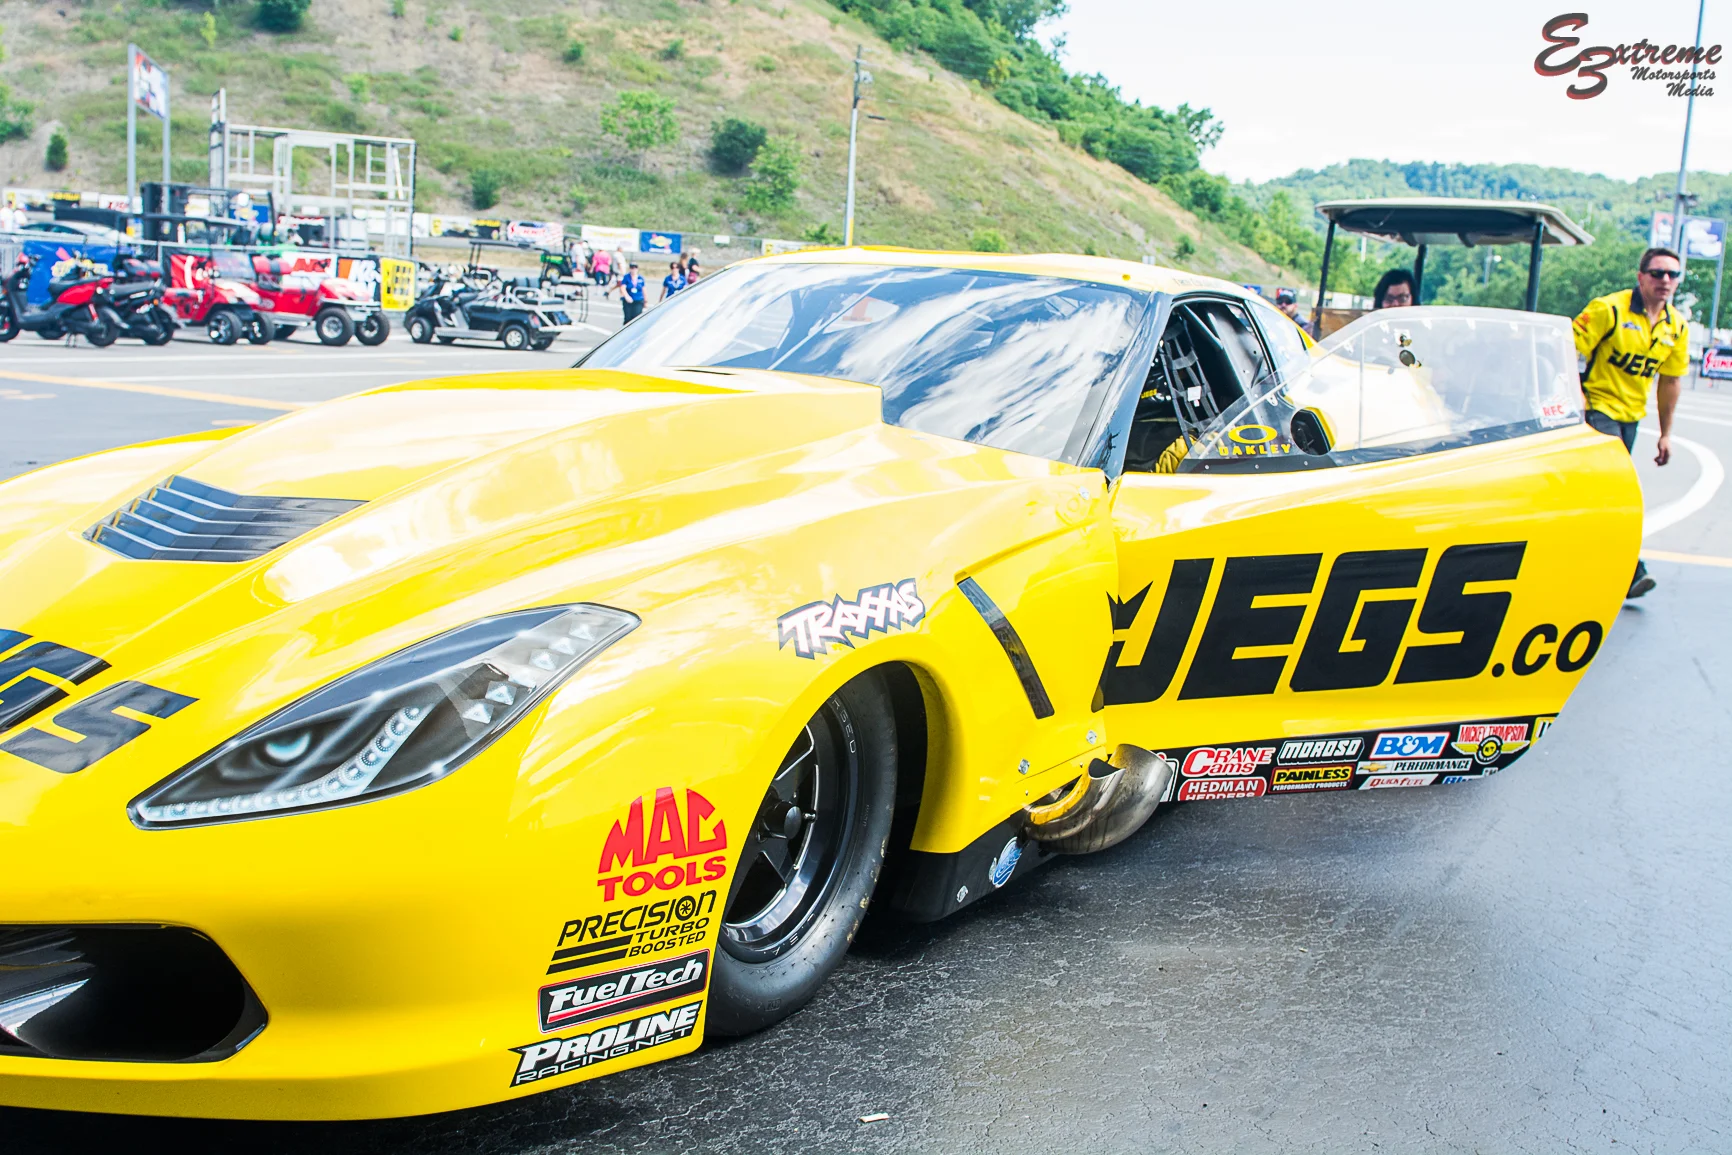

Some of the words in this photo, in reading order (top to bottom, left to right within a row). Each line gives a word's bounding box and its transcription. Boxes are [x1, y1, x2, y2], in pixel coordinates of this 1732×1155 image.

[1218, 444, 1292, 456] OAKLEY
[1280, 738, 1361, 759] MOROSO
[1375, 735, 1446, 756] B&M
[1276, 768, 1350, 783] PAINLESS
[1394, 760, 1470, 771] PERFORMANCE
[1187, 780, 1258, 793] HEDMAN
[1273, 783, 1315, 791] PERFORMANCE
[597, 786, 727, 874] MAC
[597, 856, 727, 902] TOOLS
[557, 889, 717, 947] PRECISION
[631, 917, 709, 943] TURBO
[628, 931, 706, 958] BOOSTED
[548, 958, 703, 1013] FuelTech
[514, 1002, 702, 1075] PROLINE
[515, 1025, 693, 1085] RACING.NET
